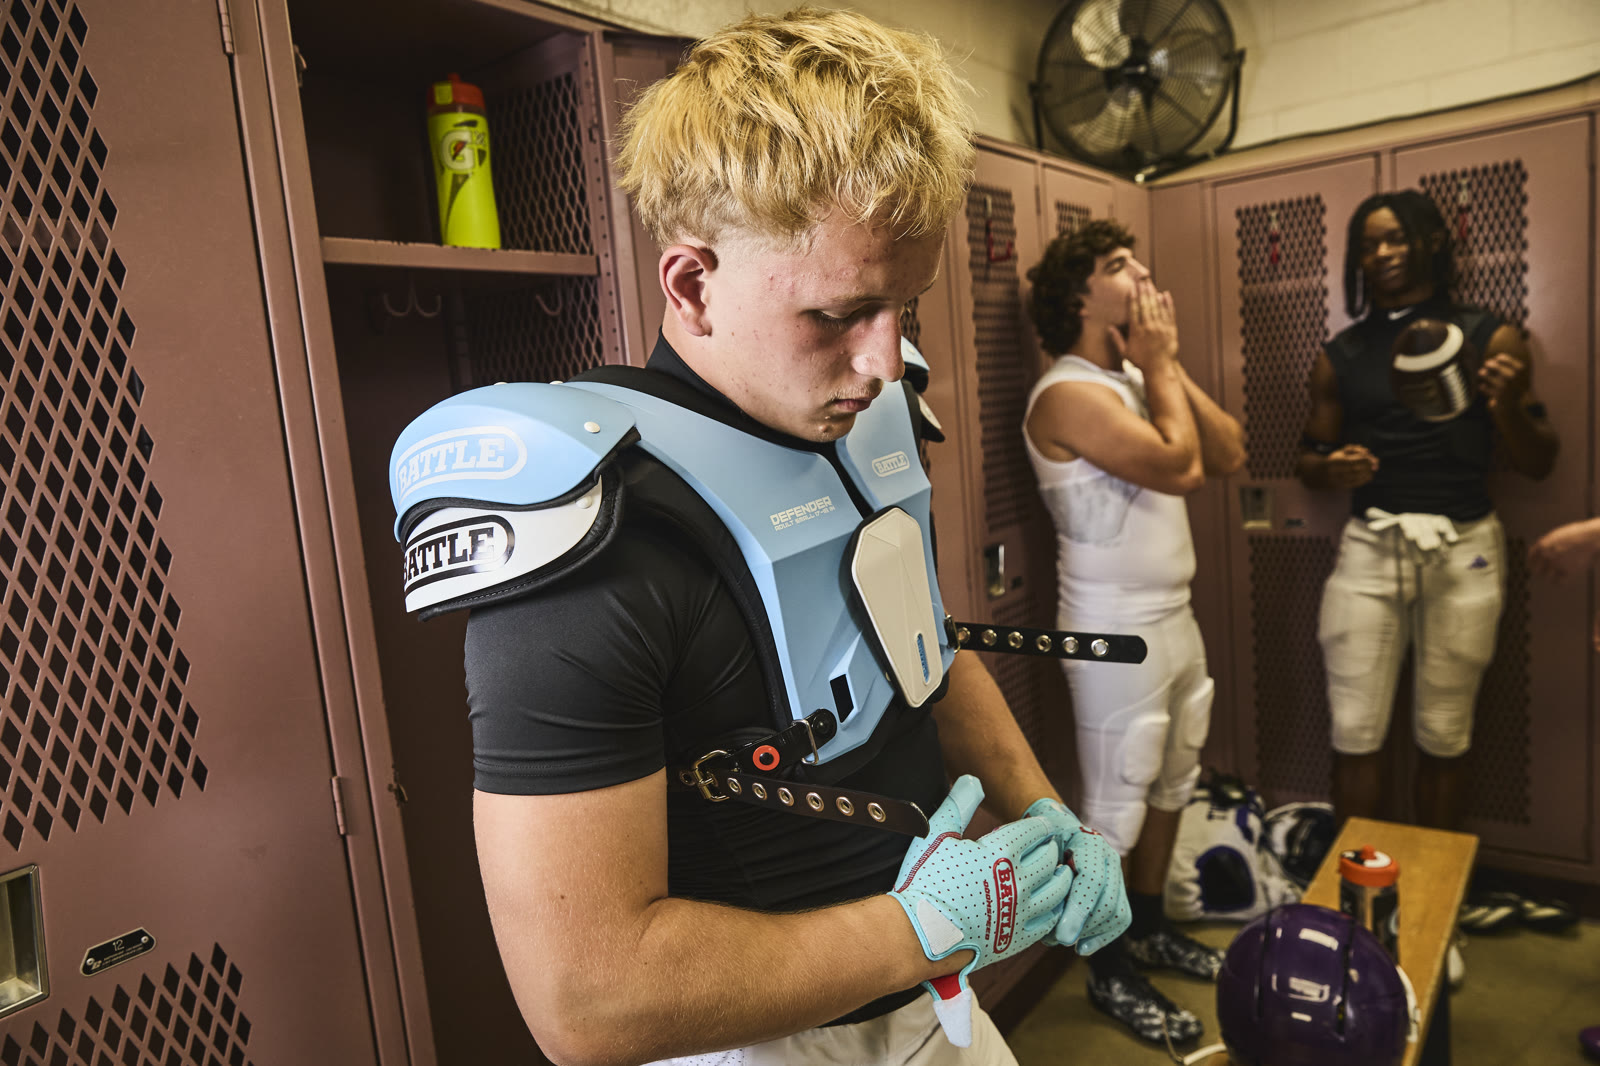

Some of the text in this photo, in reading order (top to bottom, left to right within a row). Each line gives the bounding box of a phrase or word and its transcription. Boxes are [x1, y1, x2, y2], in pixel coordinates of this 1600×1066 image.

[399, 438, 505, 496] BATTLE
[875, 454, 907, 474] BATTLE
[769, 495, 833, 526] DEFENDER
[997, 867, 1013, 947] BATTLE
[112, 938, 125, 952] 12
